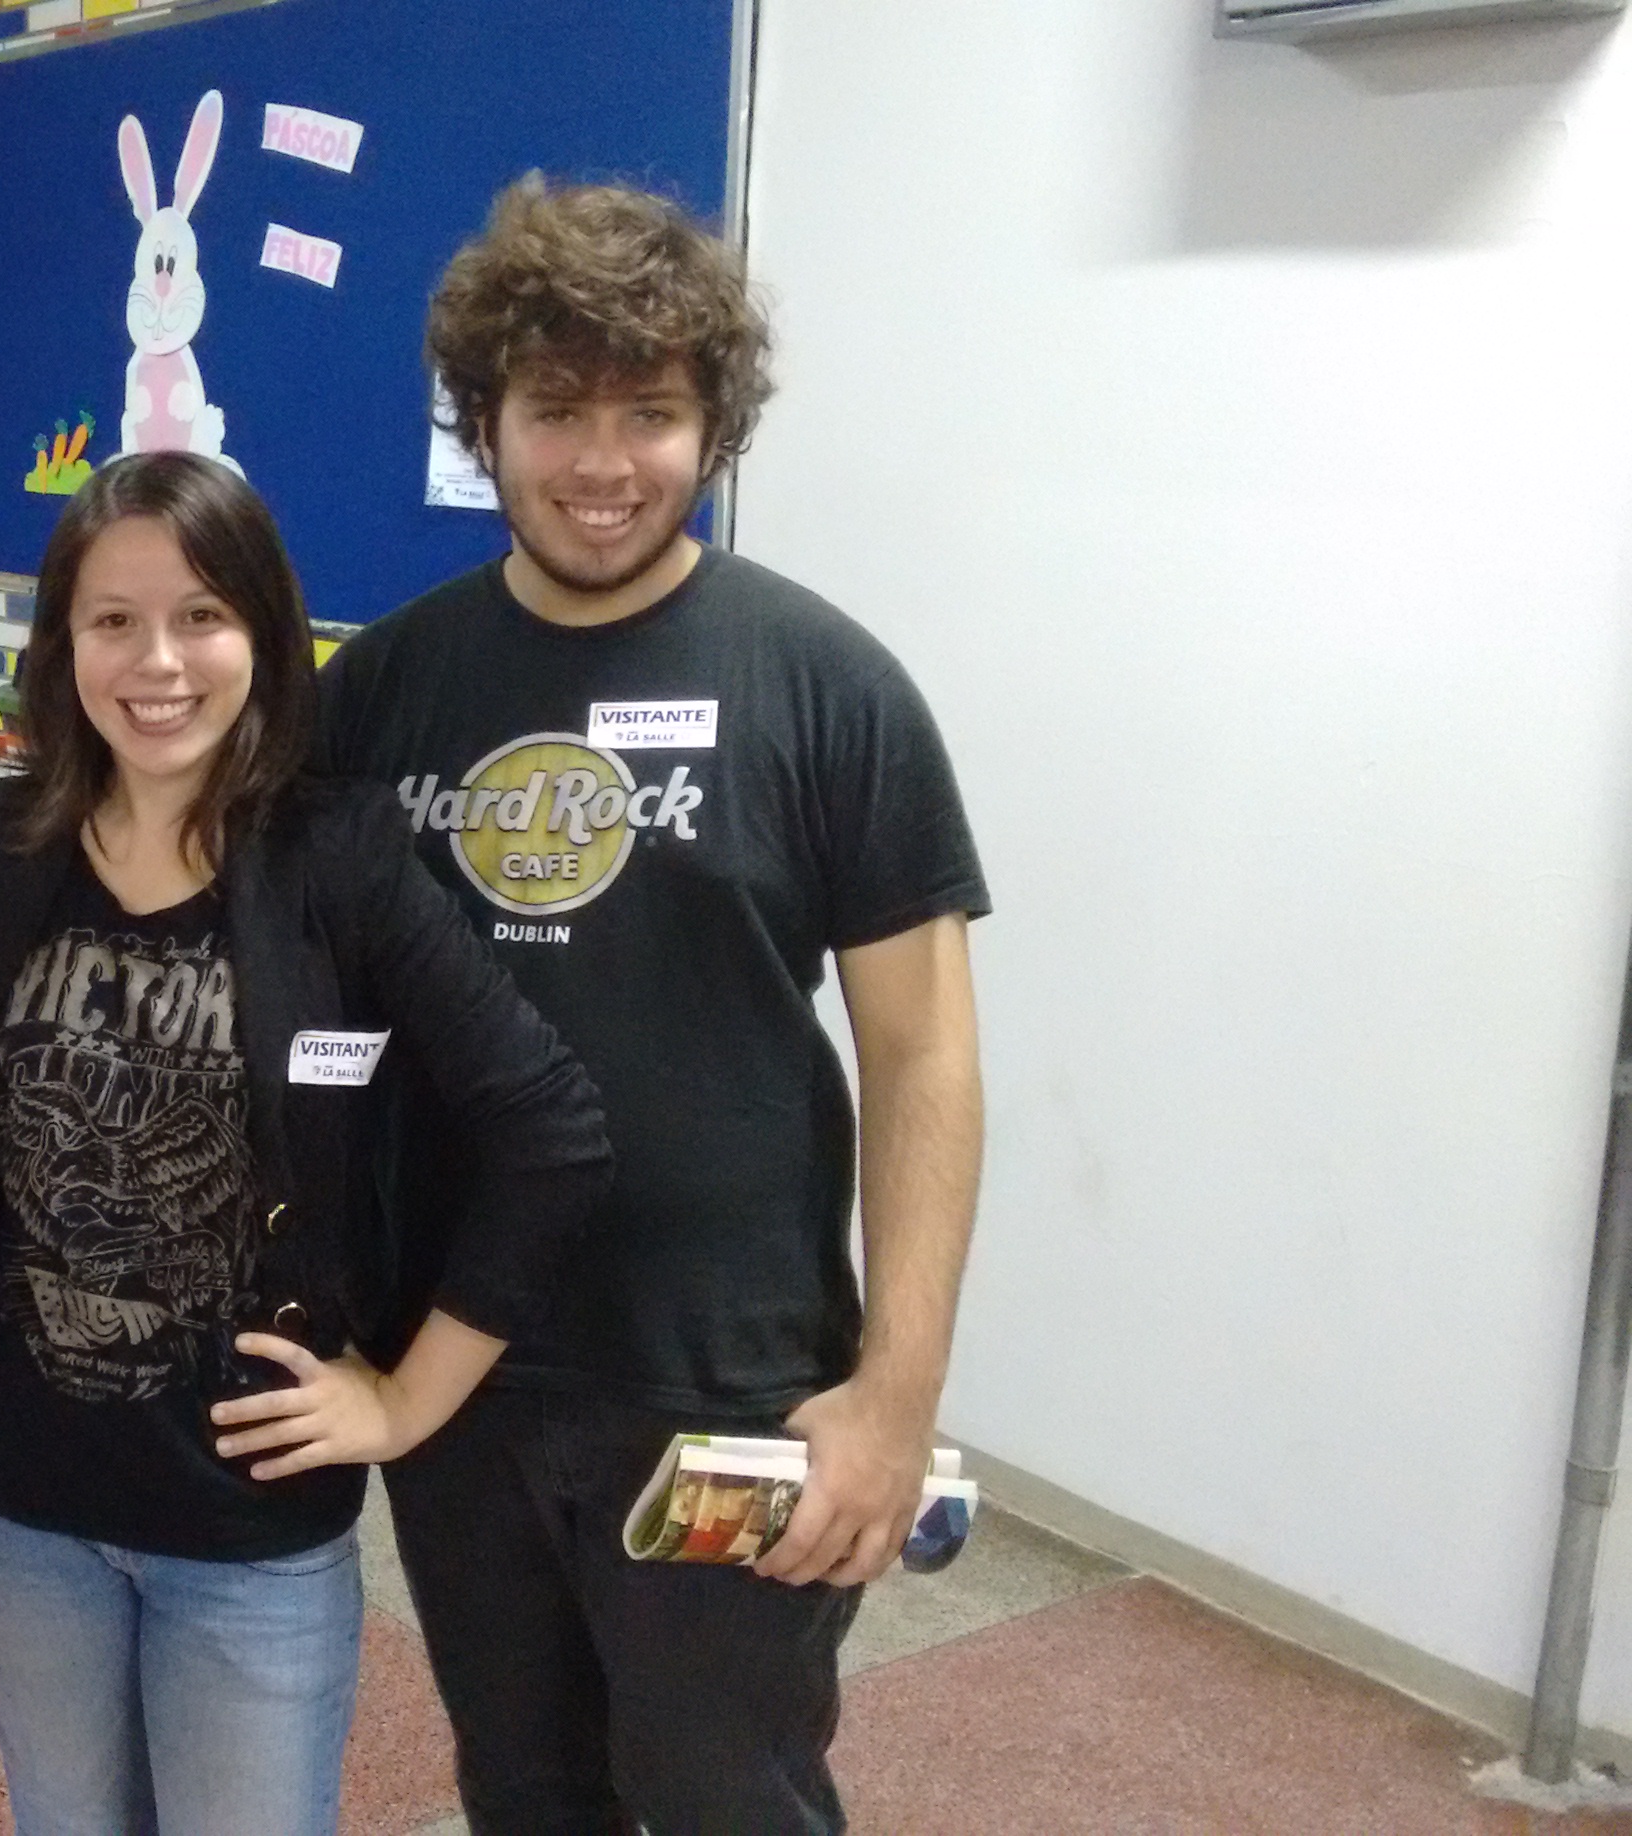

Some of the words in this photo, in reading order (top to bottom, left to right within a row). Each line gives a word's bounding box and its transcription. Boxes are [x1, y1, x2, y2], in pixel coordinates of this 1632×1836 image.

[264, 232, 335, 283] FELIZ
[601, 709, 707, 724] VISITANTE
[643, 733, 676, 741] SALLE
[397, 769, 548, 834] Hard
[547, 765, 704, 846] Rock
[499, 852, 579, 880] CAFE
[493, 921, 571, 944] DUBLIN
[129, 1045, 175, 1067] WITH
[322, 1069, 333, 1077] LA
